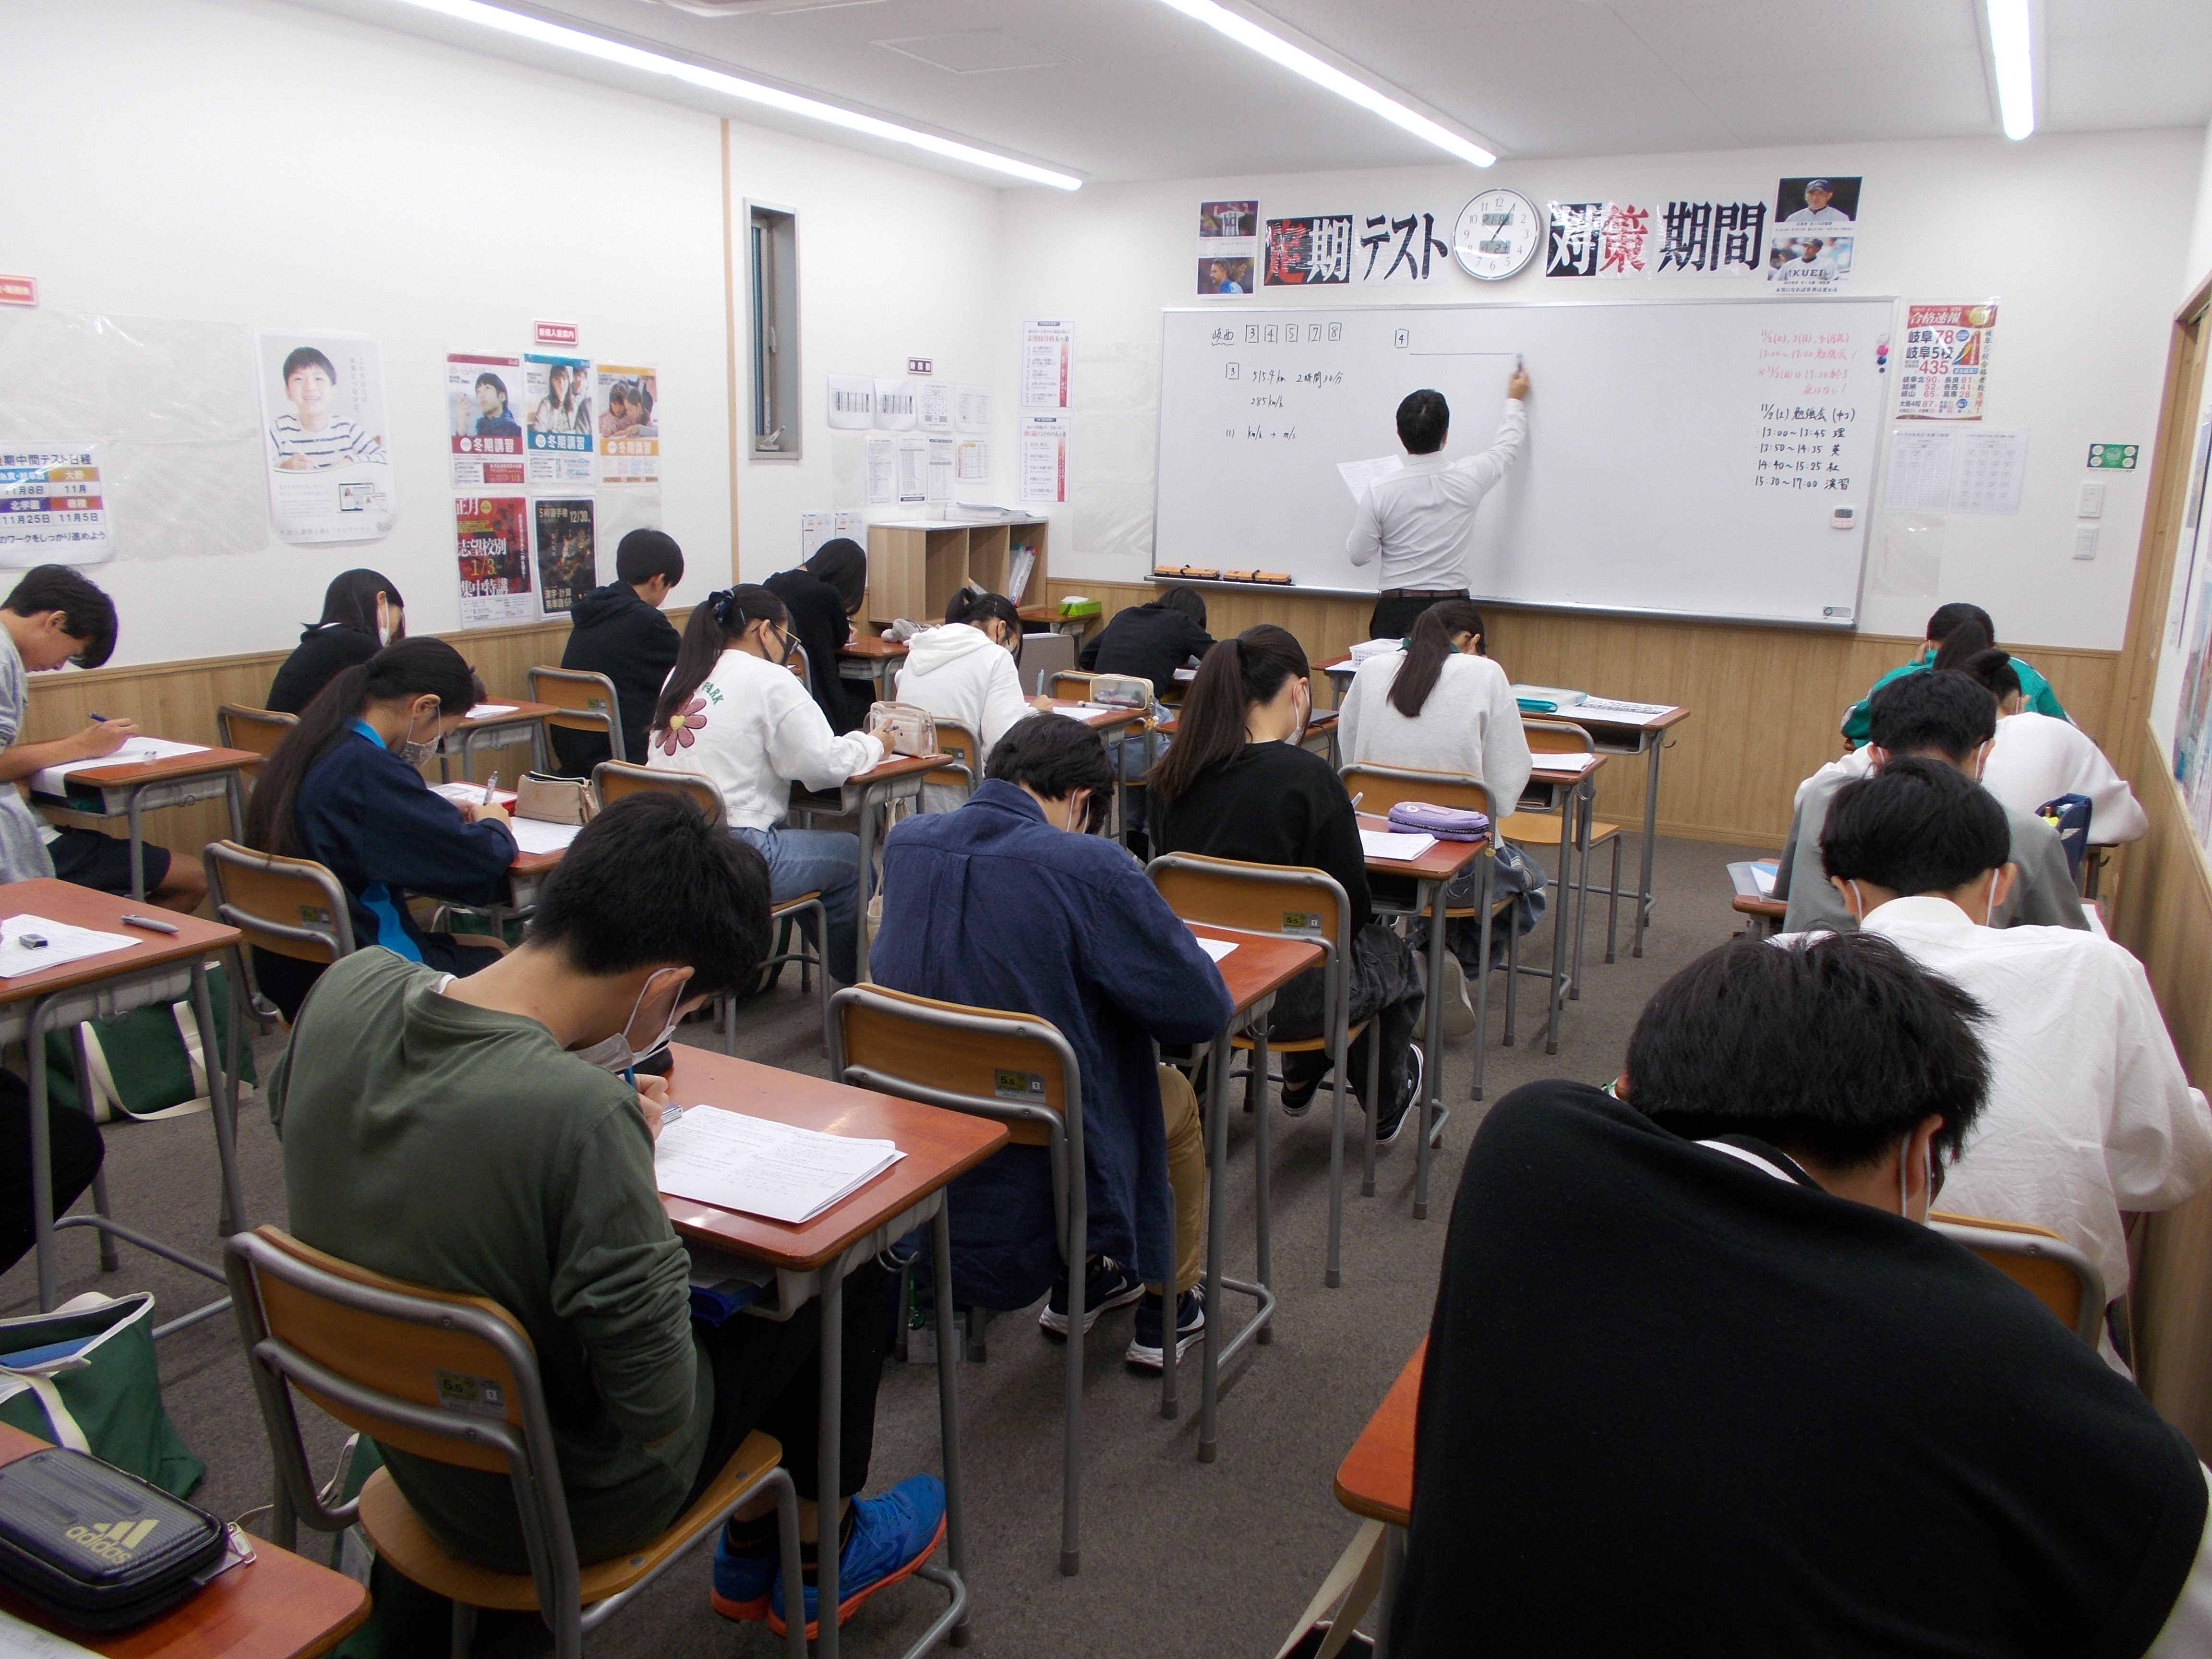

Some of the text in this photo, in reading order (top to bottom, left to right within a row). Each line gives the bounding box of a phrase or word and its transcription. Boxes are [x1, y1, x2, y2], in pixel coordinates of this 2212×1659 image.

[1481, 203, 1488, 211] 11
[1496, 198, 1503, 207] 12
[1469, 215, 1478, 224] 10
[1520, 214, 1526, 223] 2
[1464, 230, 1470, 239] 9
[1524, 230, 1529, 239] 3
[1516, 245, 1523, 254] 4
[1477, 257, 1482, 266] 7
[1490, 261, 1496, 270] 6
[1505, 257, 1511, 266] 5
[1911, 312, 1961, 324] 合格速報
[1919, 361, 1949, 374] 435
[1832, 427, 1845, 438] 理
[1831, 445, 1840, 456] 英
[0, 454, 92, 466] 期中間テスト日程
[1826, 462, 1840, 472] 社
[65, 484, 86, 493] 11月
[1824, 478, 1849, 490] 演習
[2, 513, 98, 524] 11月25日 11月5日
[701, 681, 724, 705] PARK
[66, 1526, 132, 1564] adidas
